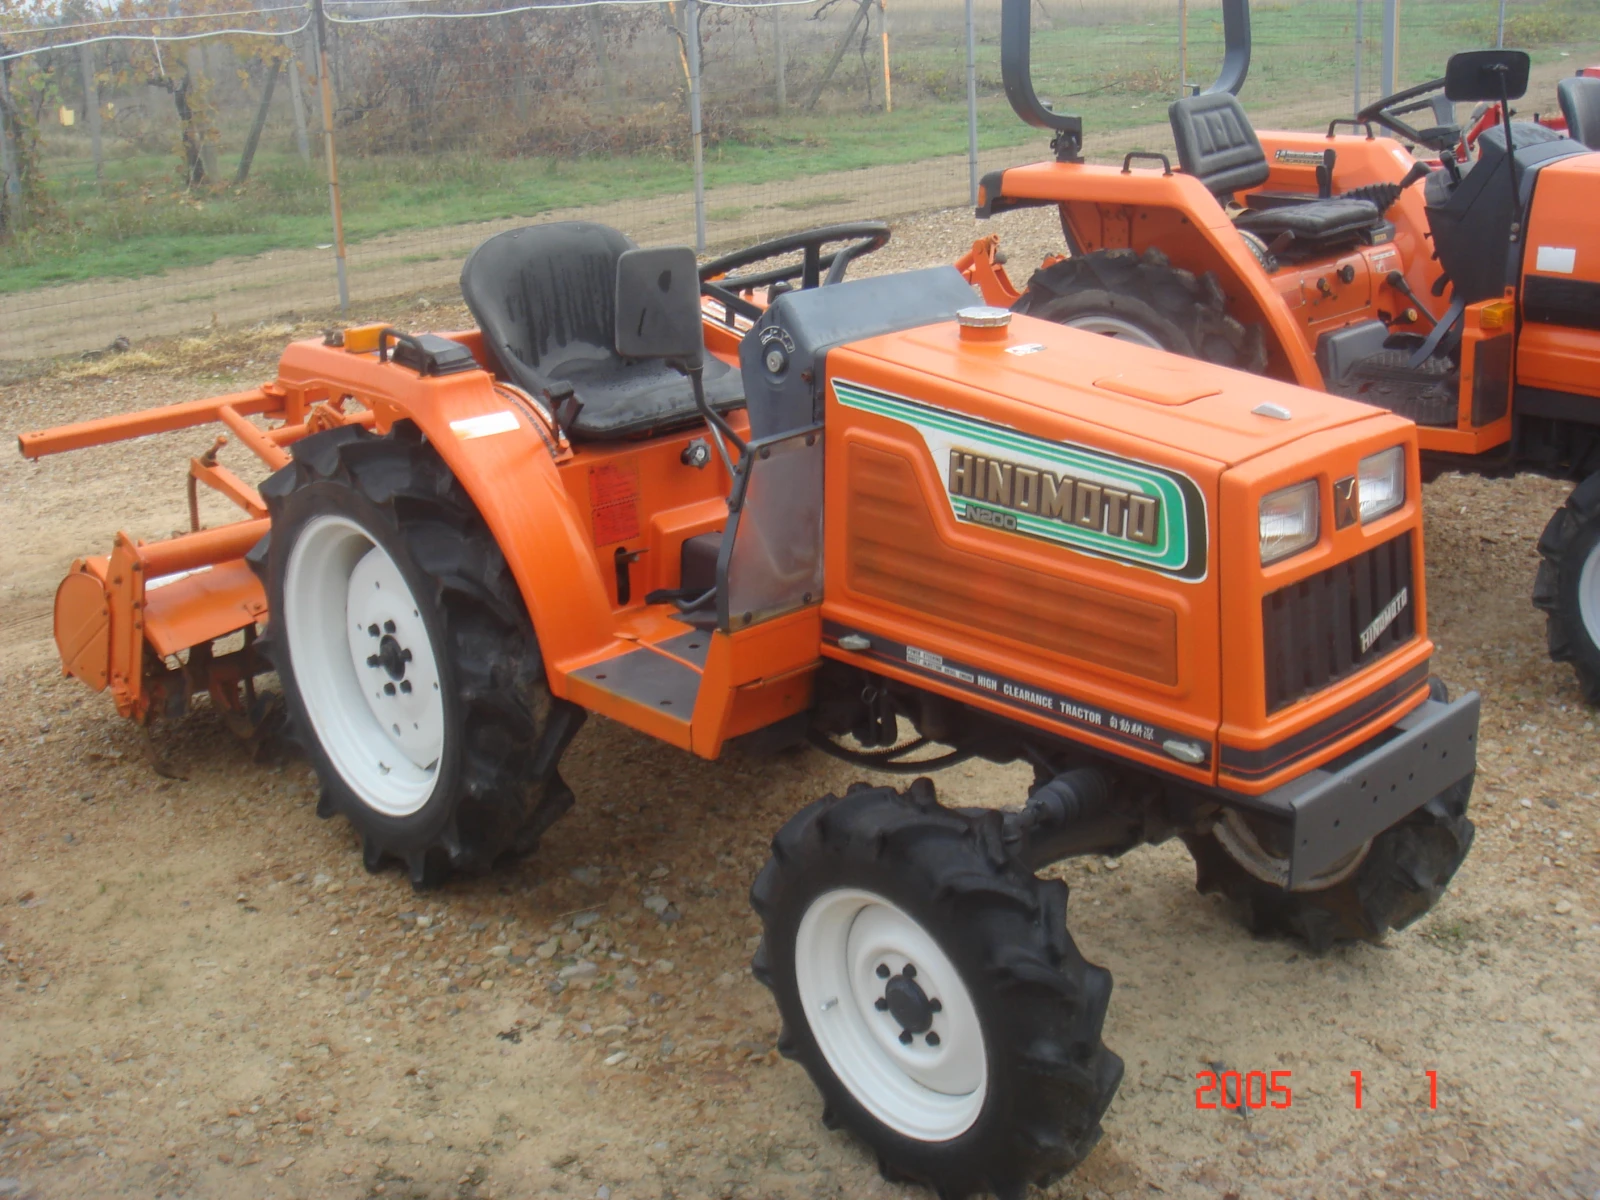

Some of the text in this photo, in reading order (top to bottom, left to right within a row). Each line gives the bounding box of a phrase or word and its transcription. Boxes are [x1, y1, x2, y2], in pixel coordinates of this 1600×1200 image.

[948, 448, 1161, 547] HINOMOTO
[966, 504, 1018, 531] N200
[1360, 587, 1408, 654] HINOMOTO
[977, 675, 1102, 726] HIGH CLEARANCE TRACTOR
